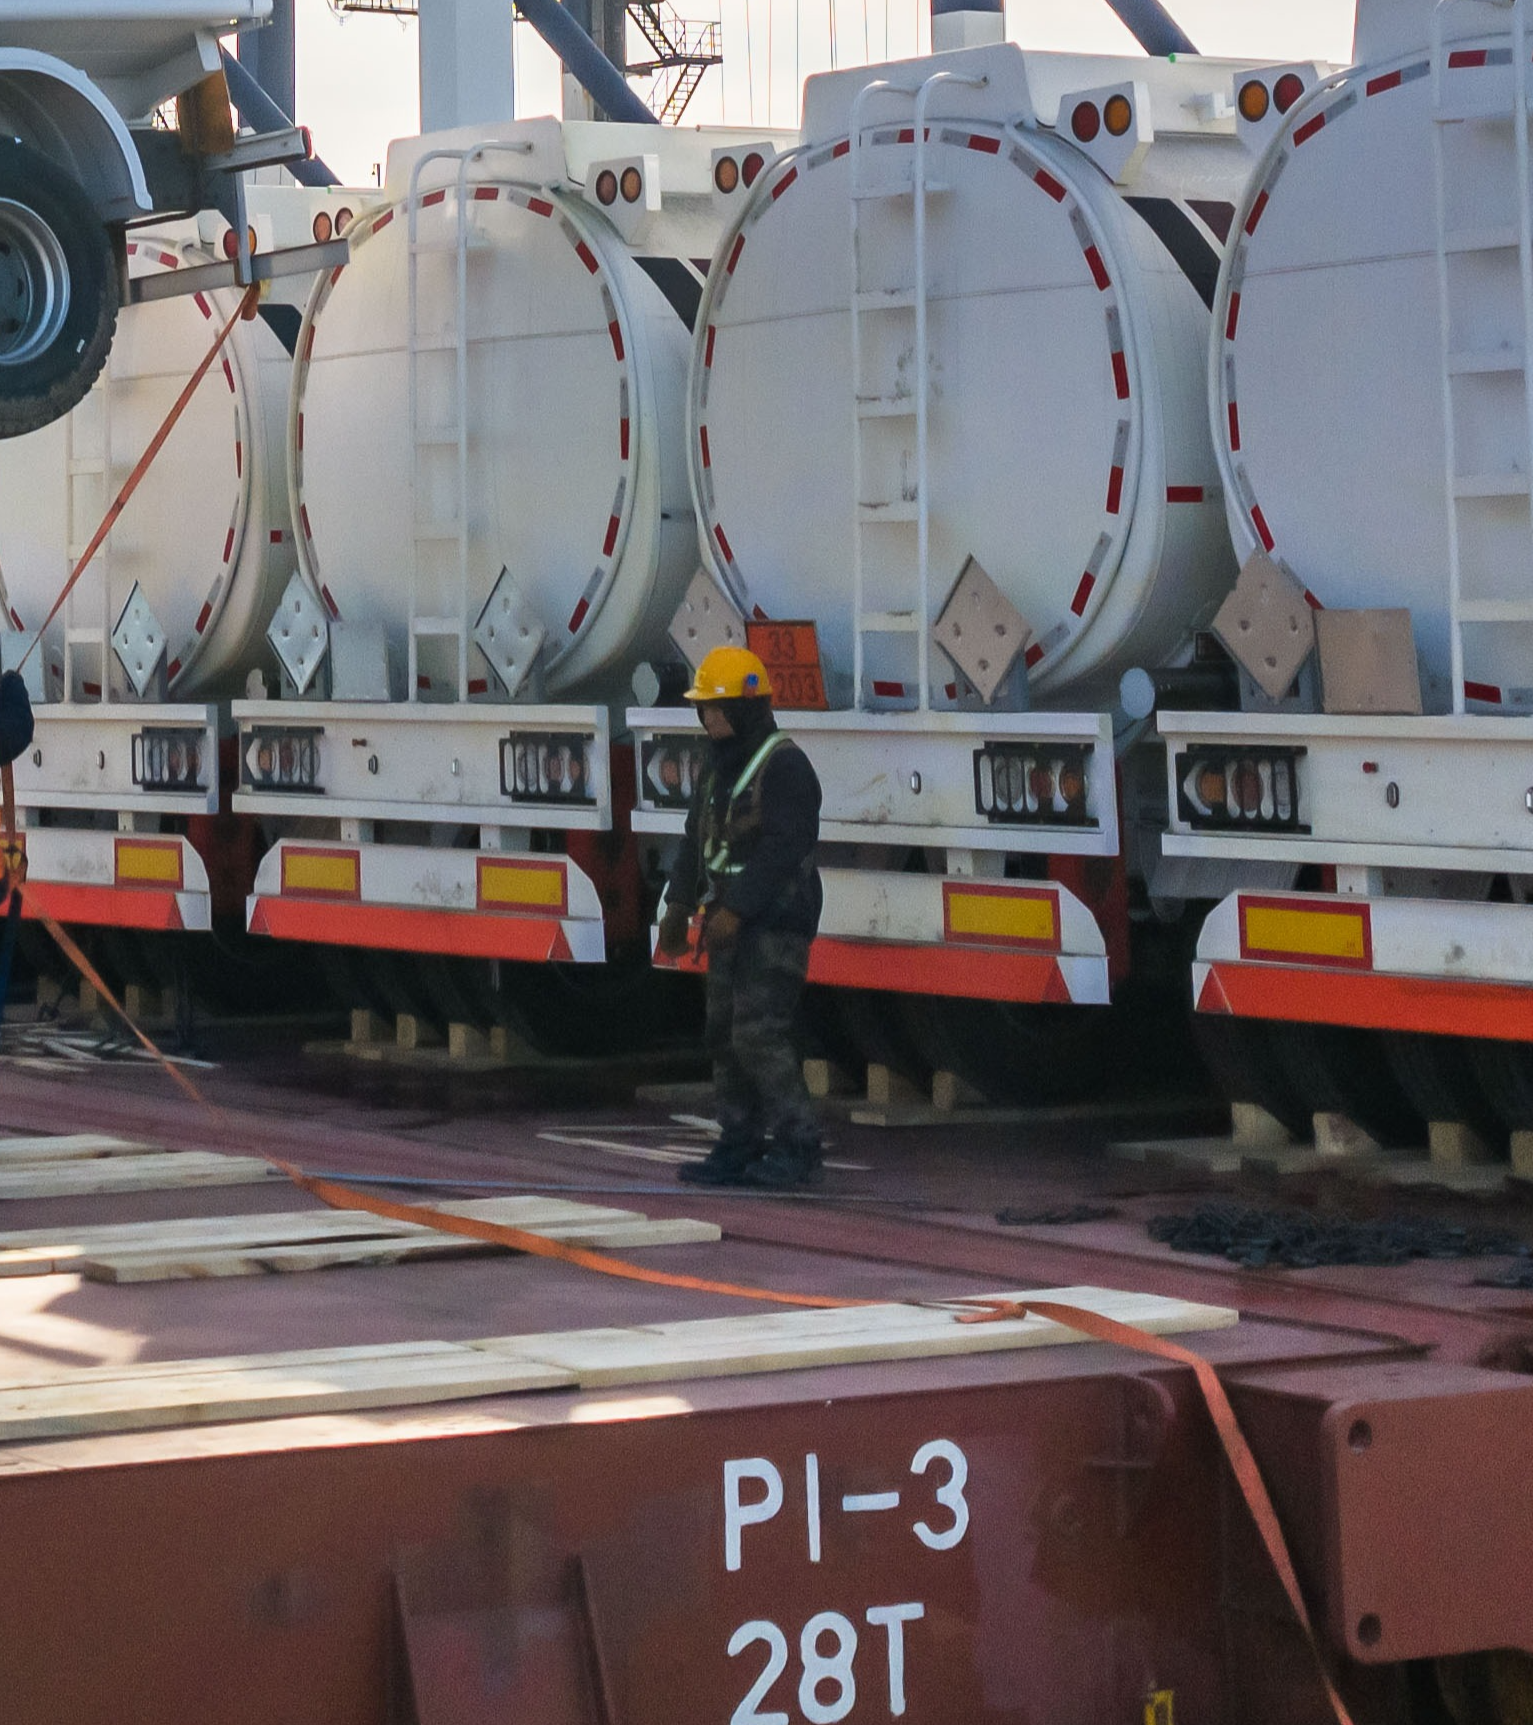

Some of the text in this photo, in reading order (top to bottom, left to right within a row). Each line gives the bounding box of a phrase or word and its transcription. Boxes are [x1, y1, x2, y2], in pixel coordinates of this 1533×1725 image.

[769, 630, 796, 661] 33
[774, 671, 819, 703] 203
[727, 1602, 925, 1725] 28T
